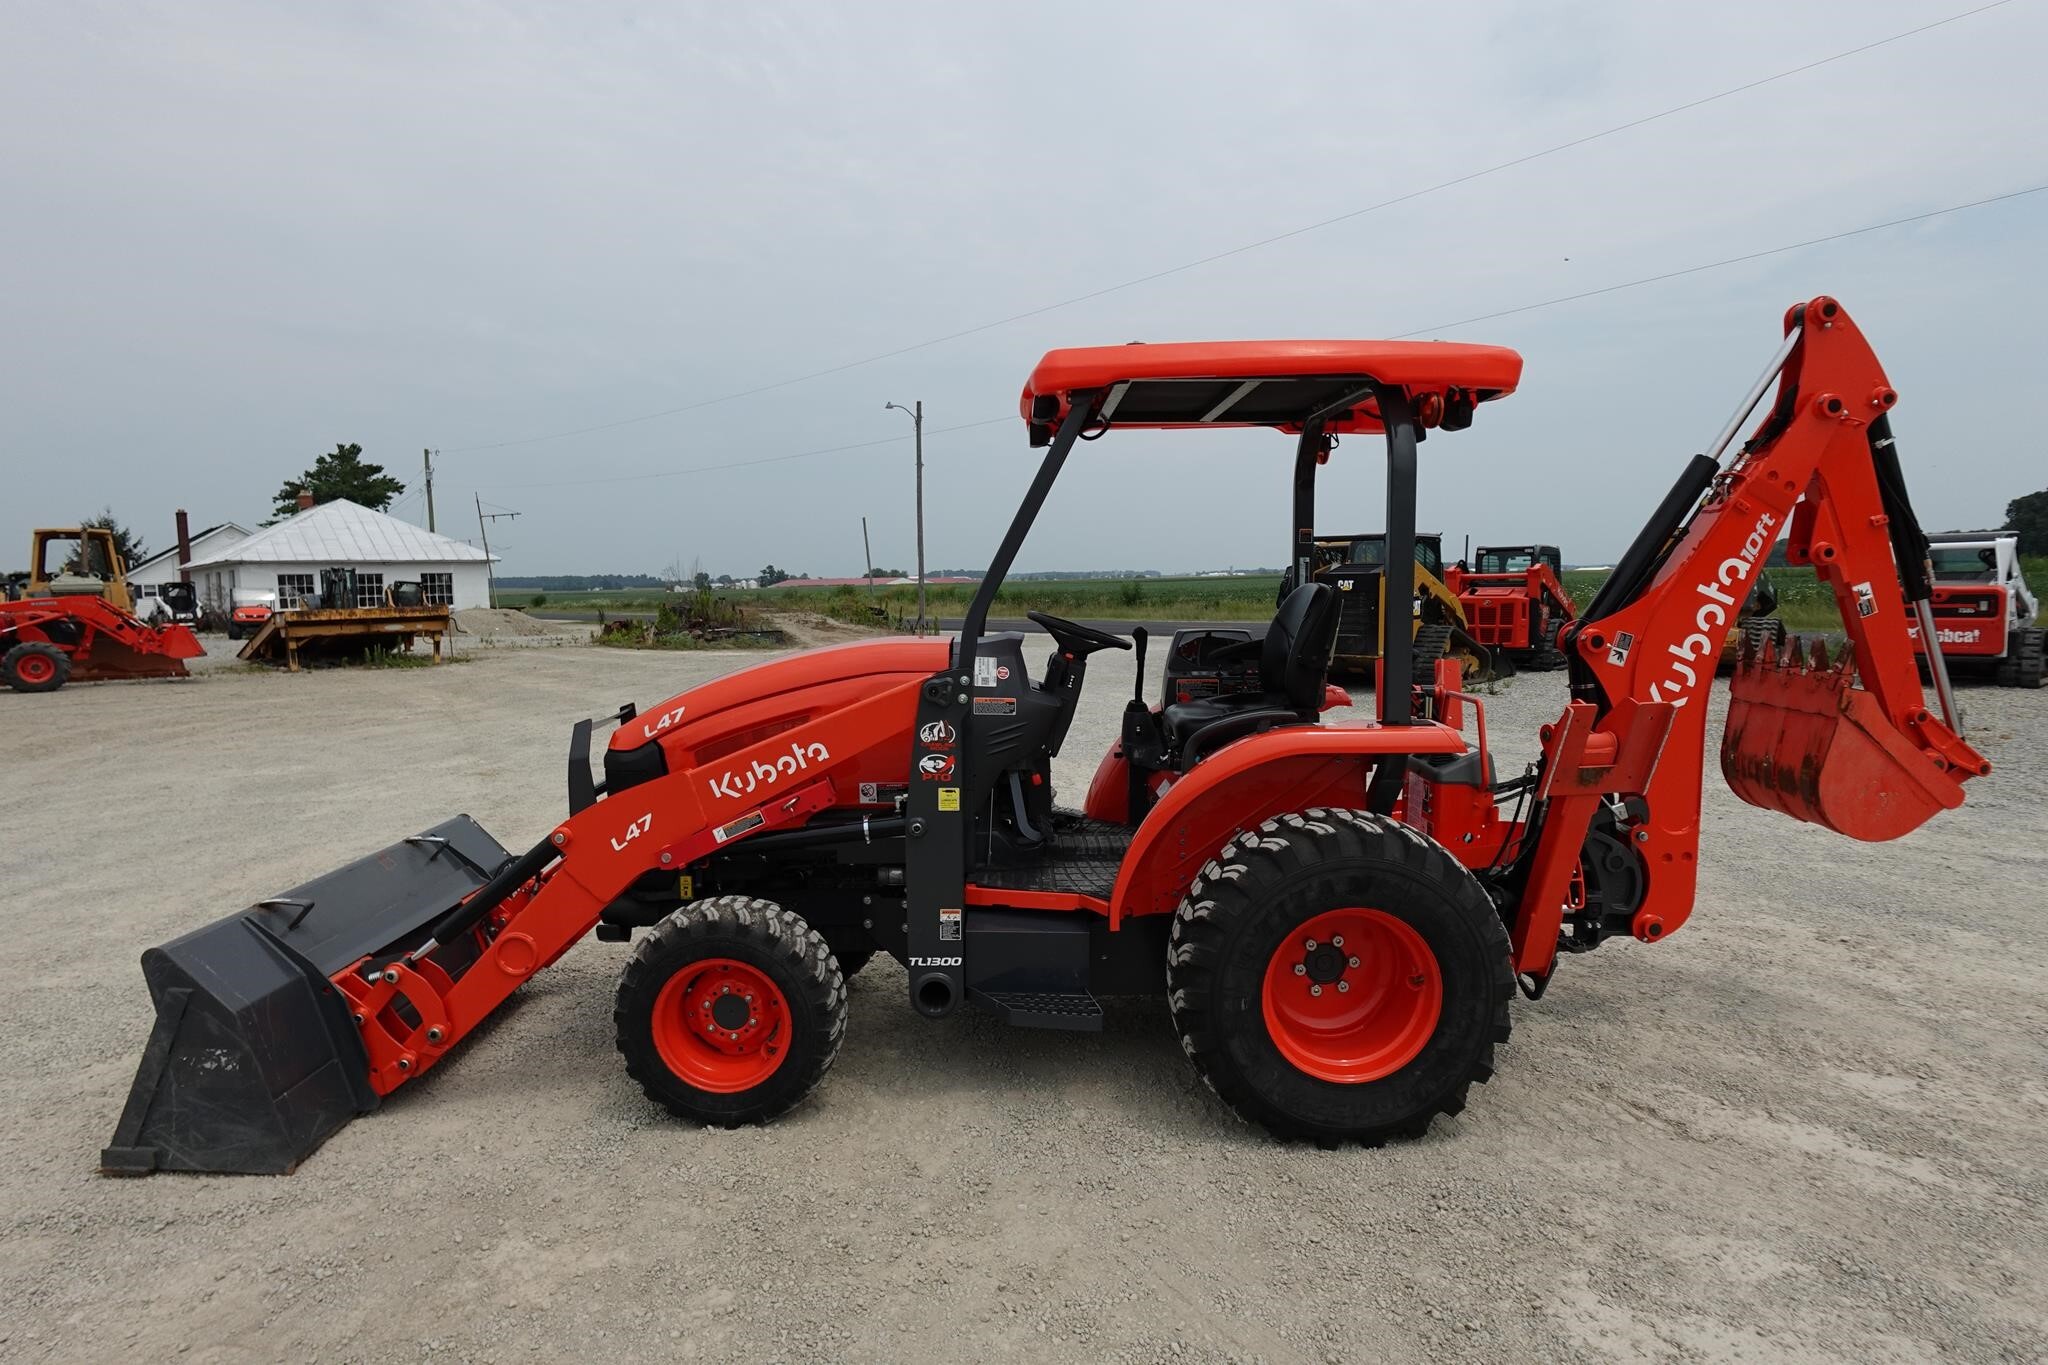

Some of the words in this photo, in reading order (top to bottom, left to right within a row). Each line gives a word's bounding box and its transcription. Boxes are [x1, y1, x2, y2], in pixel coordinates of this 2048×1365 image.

[1741, 512, 1776, 562] 10ft
[1338, 580, 1354, 590] CAT
[1936, 628, 1981, 643] obcat
[644, 706, 686, 738] L47
[709, 742, 829, 799] Kubota
[922, 773, 952, 782] PTO
[611, 813, 652, 851] L47
[909, 957, 962, 967] TL1300
